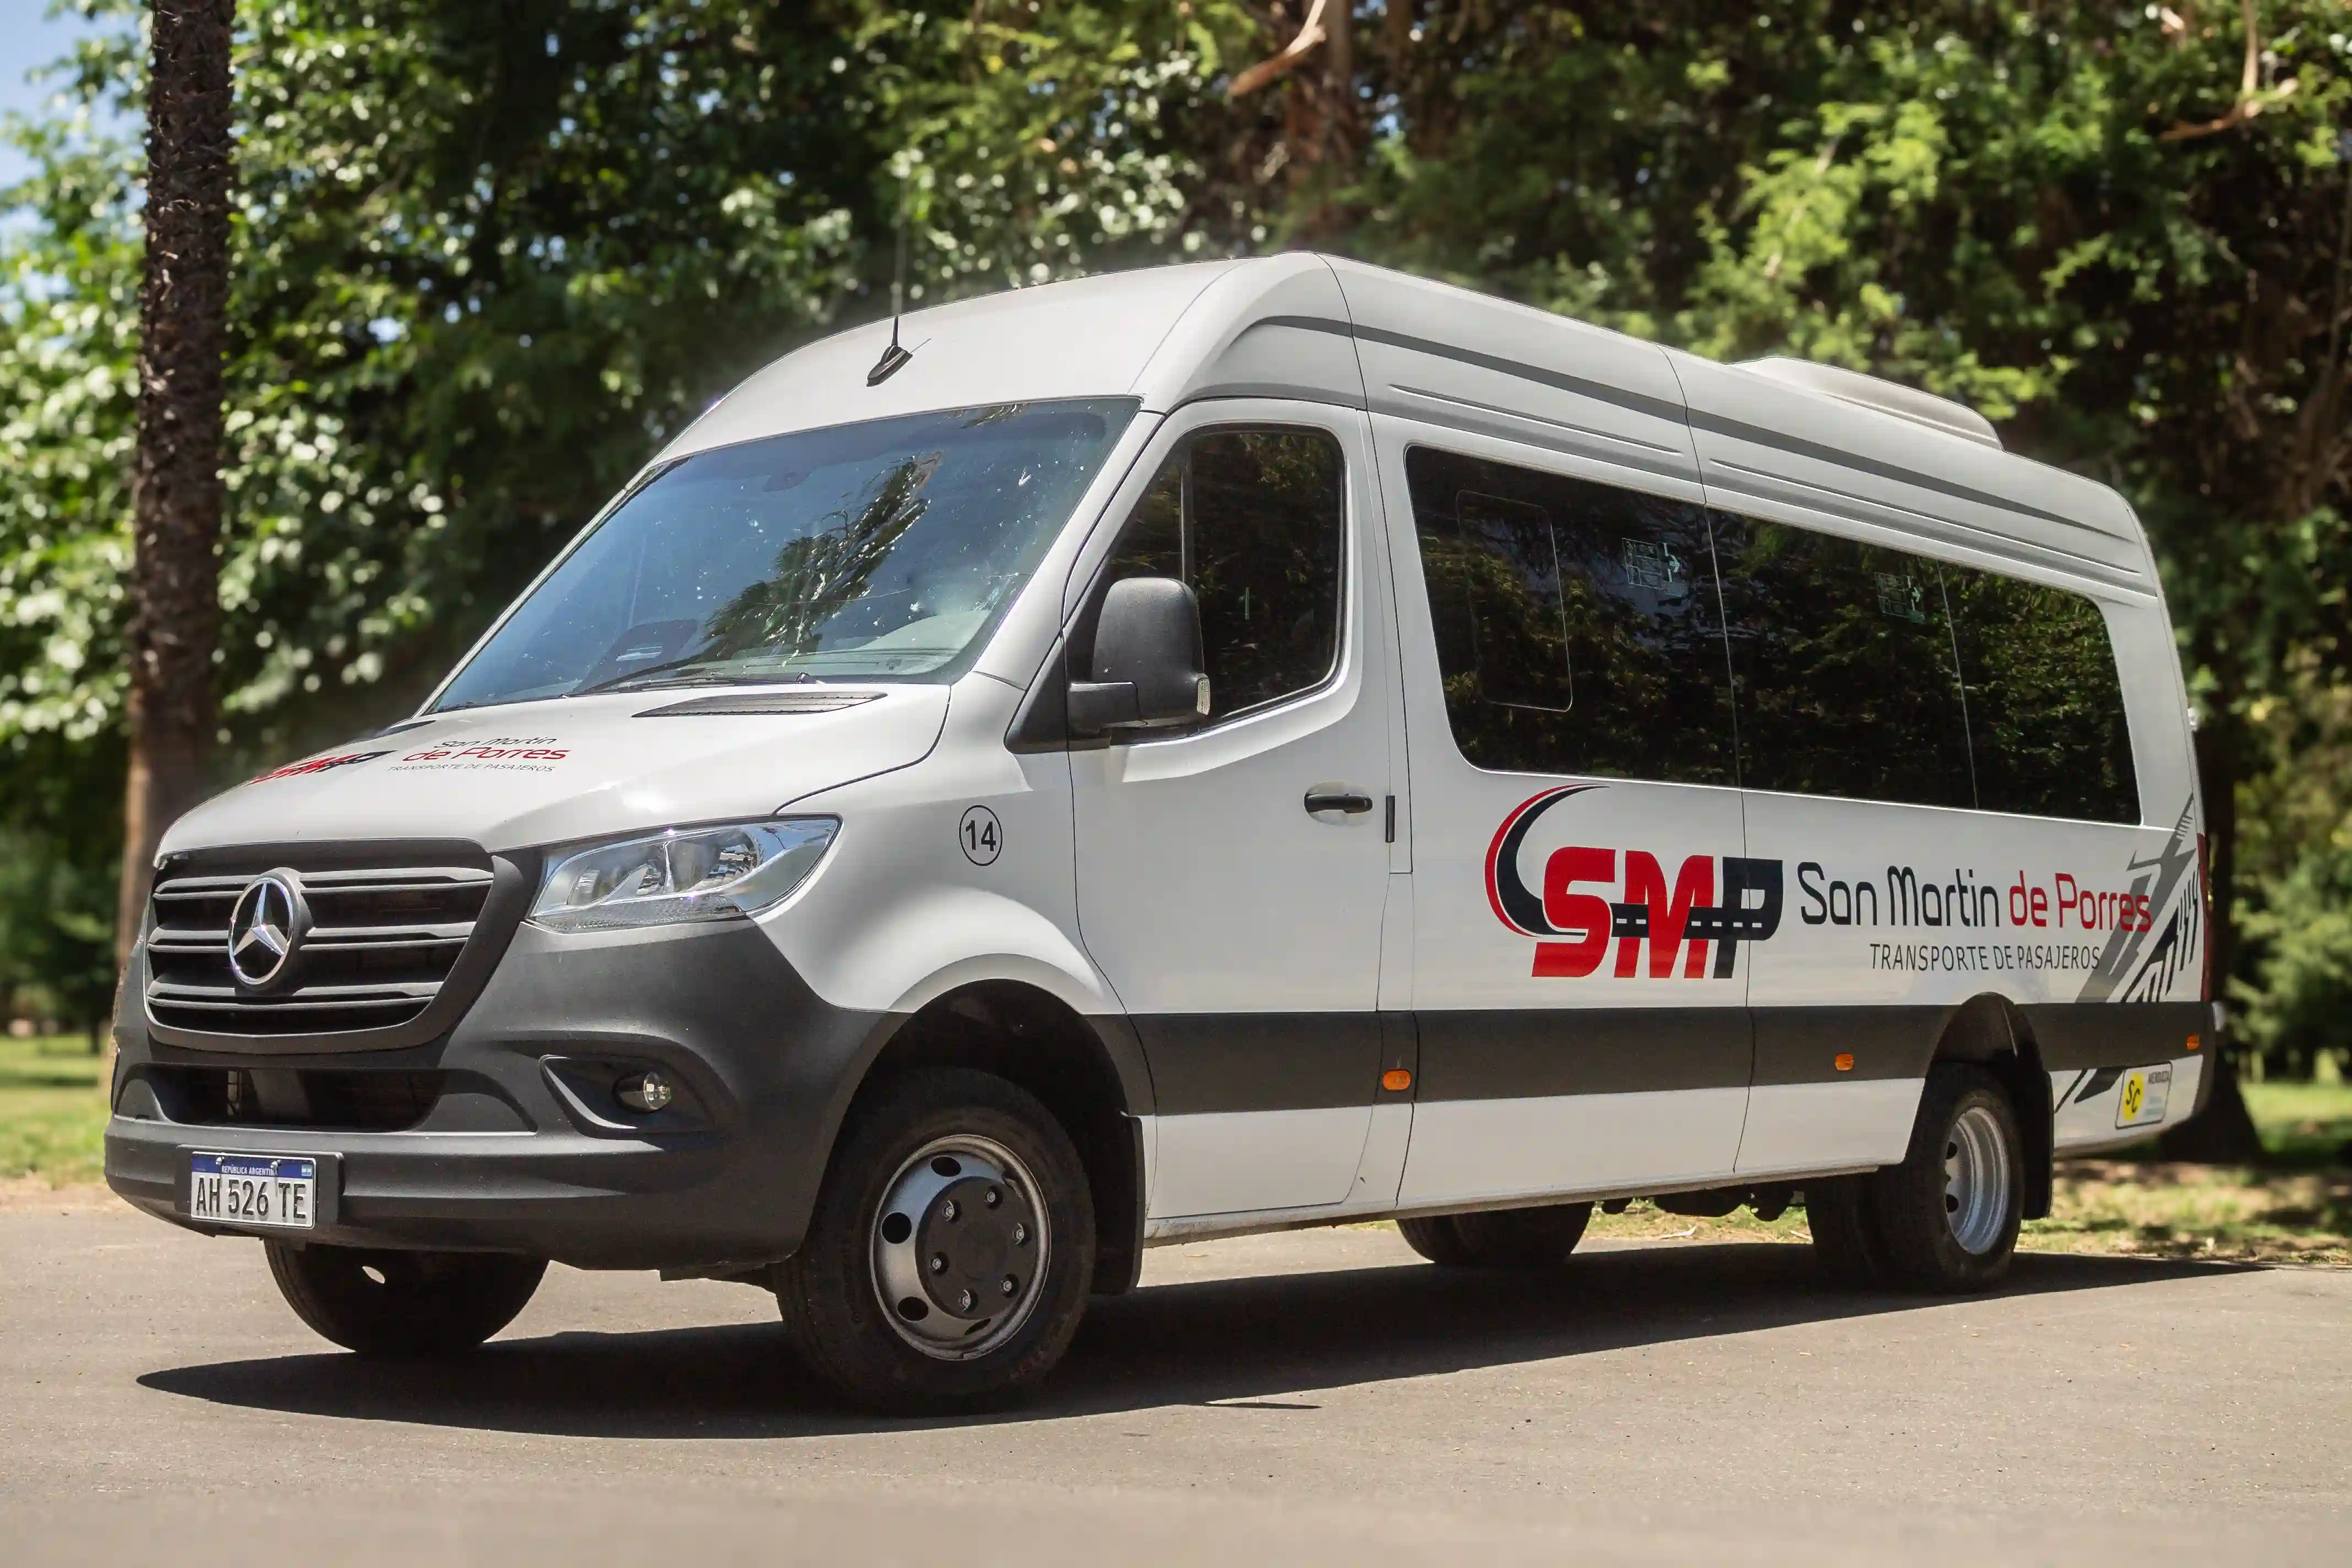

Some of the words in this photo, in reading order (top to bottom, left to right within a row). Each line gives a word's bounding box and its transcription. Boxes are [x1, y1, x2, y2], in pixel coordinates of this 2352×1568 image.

[402, 749, 451, 761] de
[451, 747, 571, 760] Porres
[479, 764, 556, 772] PASAJEROS
[965, 819, 997, 852] 14
[1798, 862, 1877, 925] San
[1887, 865, 2000, 927] Martin
[2010, 870, 2048, 927] de
[2055, 873, 2152, 932] Porres
[1531, 846, 1783, 979] SMP
[1870, 943, 1989, 971] TRANSPORTE
[1993, 945, 2012, 970] DE
[2017, 945, 2100, 970] PASAJEROS
[221, 1164, 247, 1174] REPÚBLICA
[249, 1167, 278, 1176] ARGENTINA
[197, 1177, 221, 1213] AH
[228, 1179, 269, 1216] 526
[279, 1182, 306, 1219] TE
